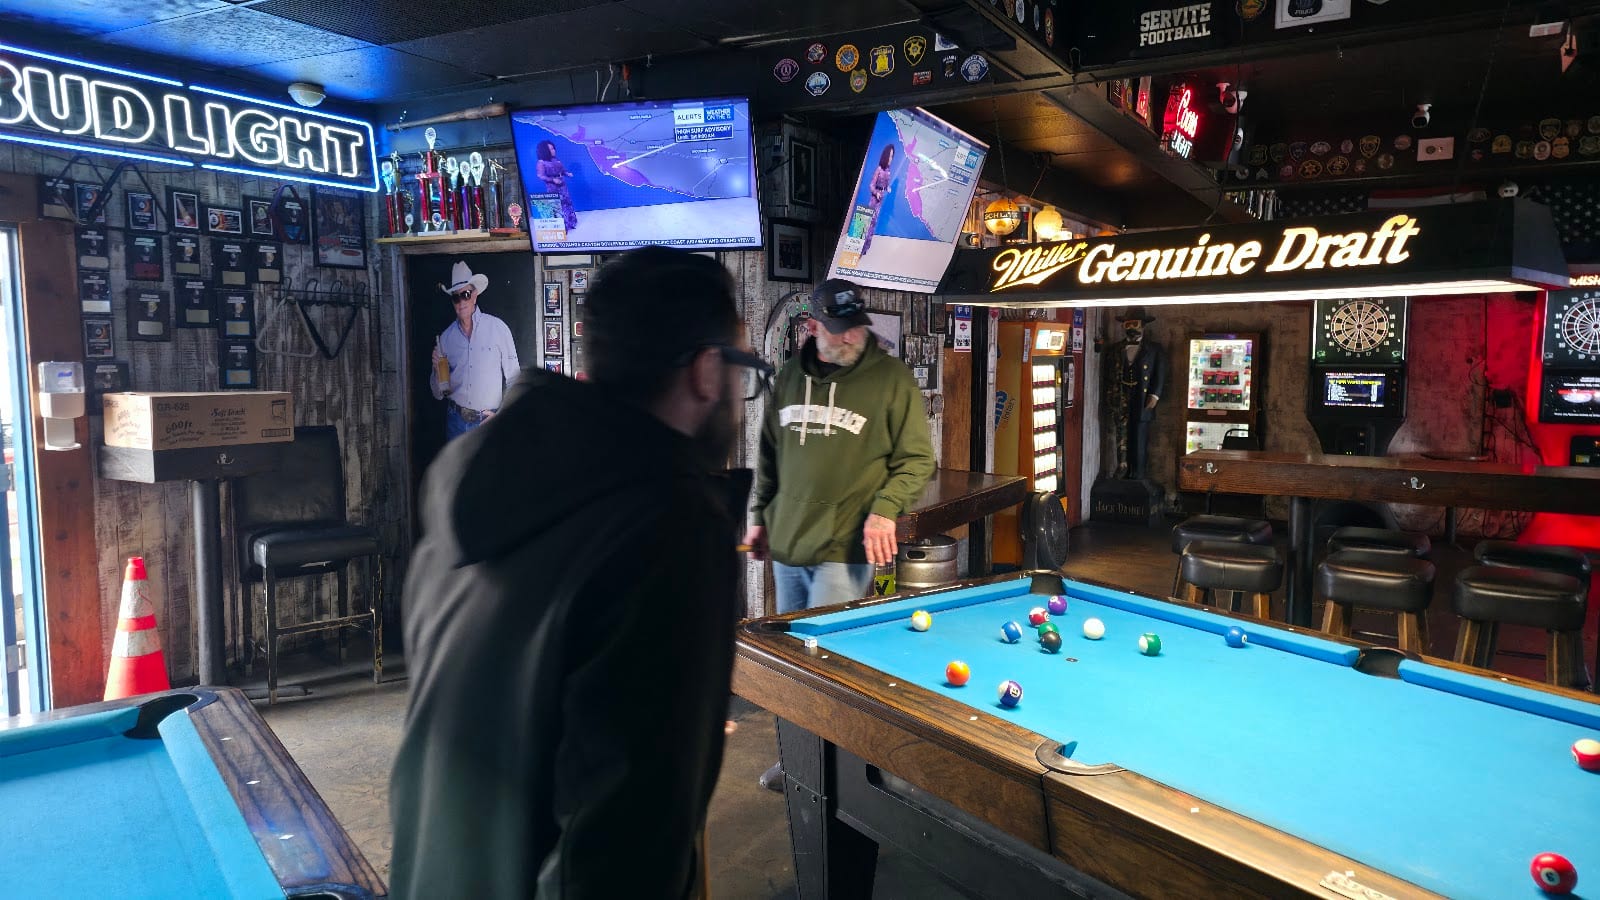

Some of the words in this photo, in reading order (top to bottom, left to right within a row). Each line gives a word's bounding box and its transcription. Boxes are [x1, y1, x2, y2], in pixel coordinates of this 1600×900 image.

[1140, 3, 1212, 32] SERVITE
[1140, 23, 1211, 47] FOOTBALL
[677, 113, 702, 121] ALERTS
[704, 125, 731, 133] ADVISORY
[164, 94, 364, 178] LIGHT
[1171, 129, 1193, 159] LIGHT
[990, 241, 1088, 293] Miller
[1077, 233, 1262, 284] Genuine
[1265, 213, 1421, 273] Draft
